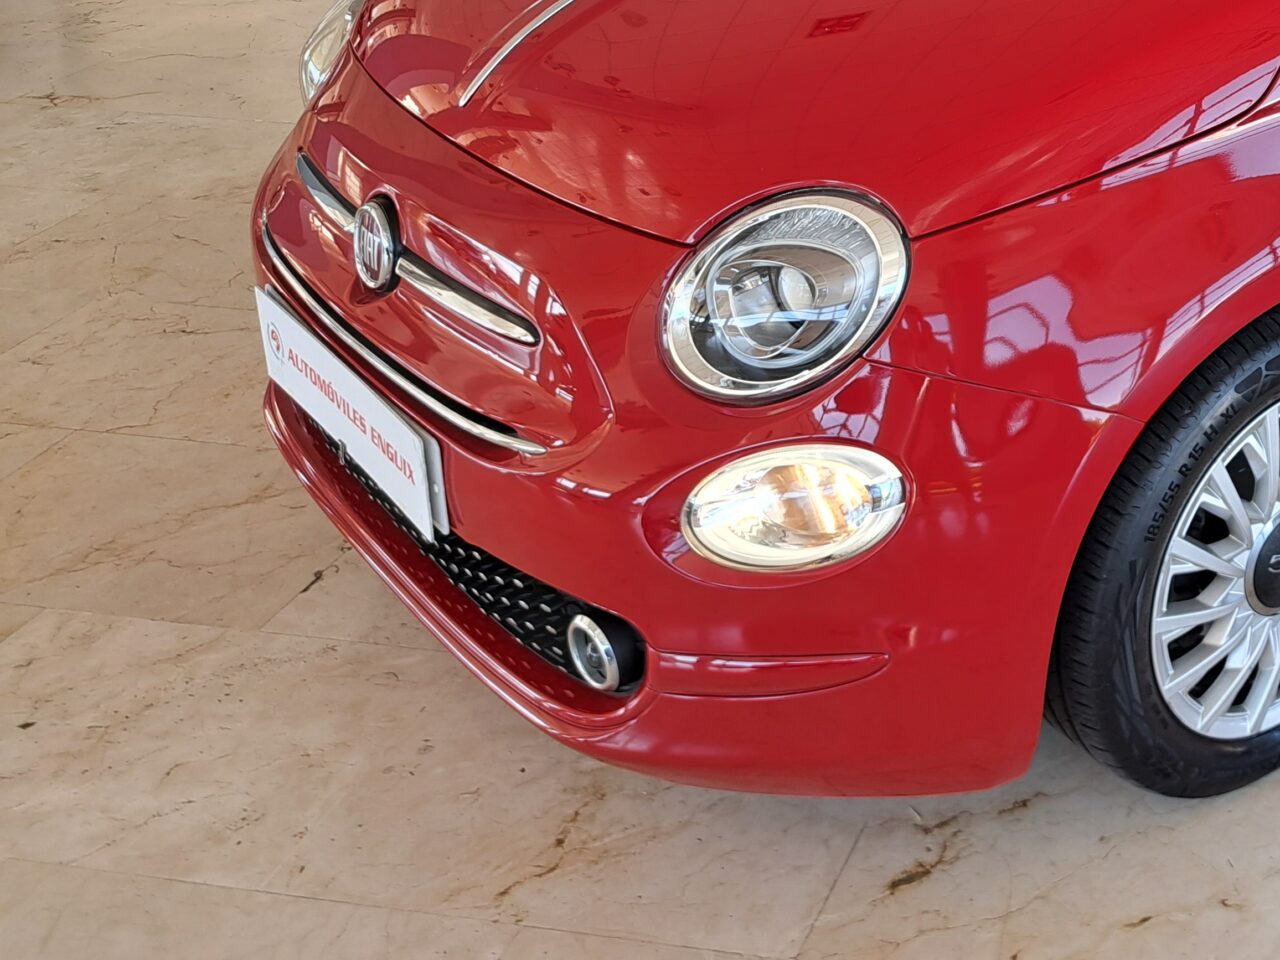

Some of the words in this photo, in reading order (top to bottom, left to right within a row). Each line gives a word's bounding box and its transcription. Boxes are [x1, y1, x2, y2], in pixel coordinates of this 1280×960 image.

[360, 225, 381, 271] FIAT
[287, 347, 367, 435] AUTOMÓVILES
[370, 426, 416, 486] ENGUIX
[1144, 481, 1181, 542] 185/55
[1203, 424, 1219, 442] H
[1220, 402, 1240, 424] XL
